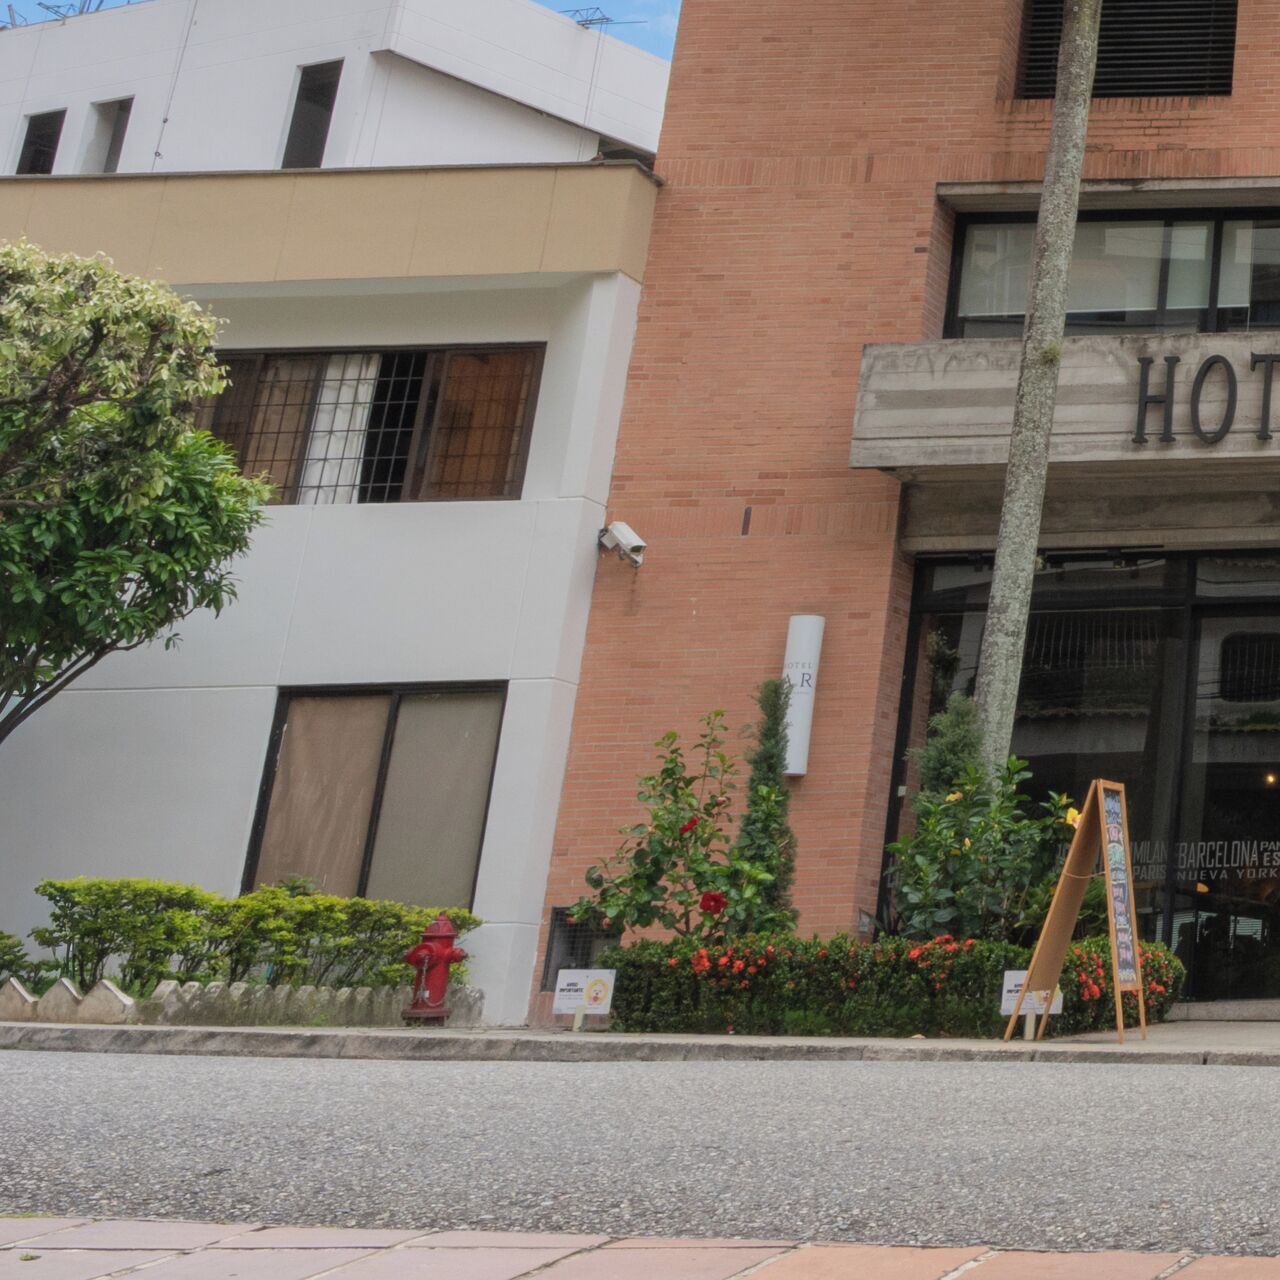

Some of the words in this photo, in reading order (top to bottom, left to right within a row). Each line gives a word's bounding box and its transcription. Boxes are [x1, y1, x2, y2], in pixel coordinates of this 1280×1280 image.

[1177, 839, 1259, 869] BARCELONA
[1176, 870, 1229, 881] NUEVA
[1236, 868, 1278, 880] YORK
